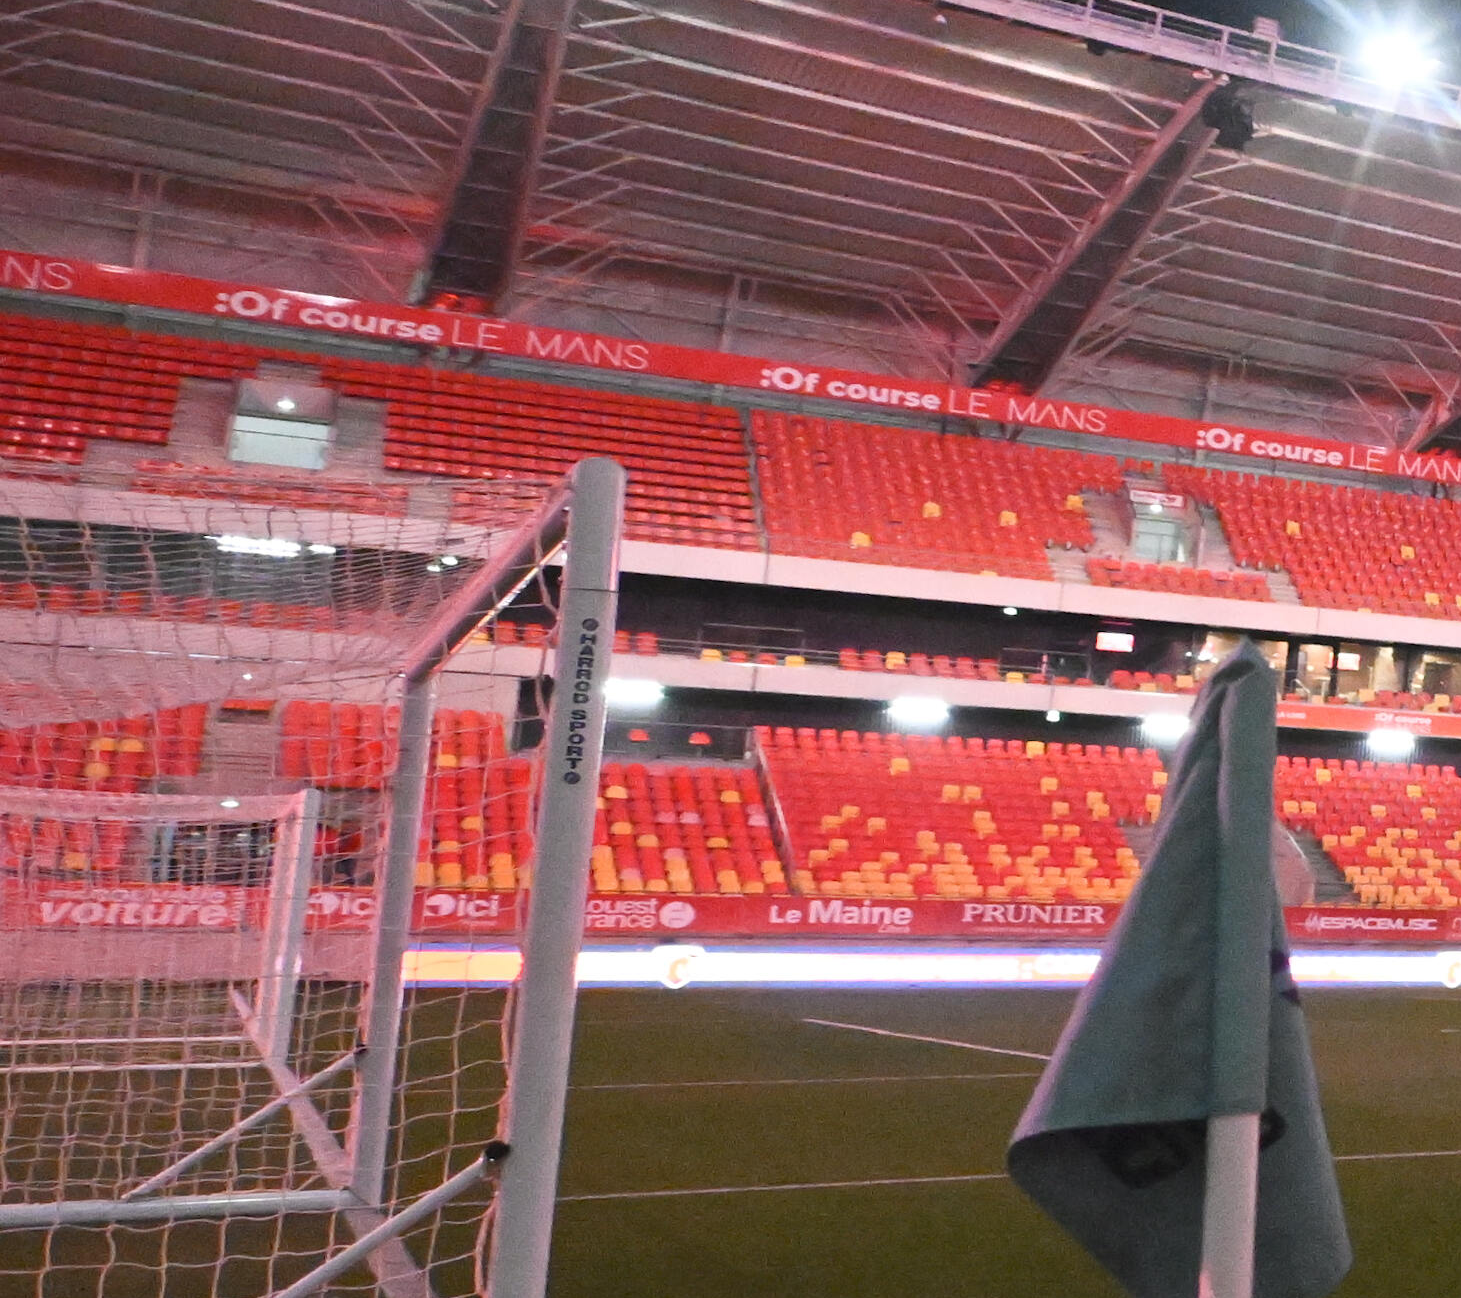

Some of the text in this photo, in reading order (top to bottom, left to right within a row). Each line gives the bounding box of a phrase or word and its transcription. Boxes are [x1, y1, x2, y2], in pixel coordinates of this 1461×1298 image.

[3, 255, 75, 291] NS
[299, 307, 444, 342] course
[452, 319, 505, 351] LE
[525, 330, 649, 369] MANS
[826, 379, 942, 410] course
[948, 389, 993, 418] LE
[1008, 398, 1107, 433] MANS
[1250, 439, 1344, 467] course
[1348, 446, 1387, 473] LE
[565, 634, 597, 769] HARROD SPORT
[40, 901, 228, 925] voiture
[341, 891, 376, 916] ic
[457, 894, 499, 917] ici
[587, 898, 658, 914] ouest
[769, 900, 913, 925] Le Maine
[961, 903, 1105, 924] PRUNIER
[585, 914, 657, 929] rance
